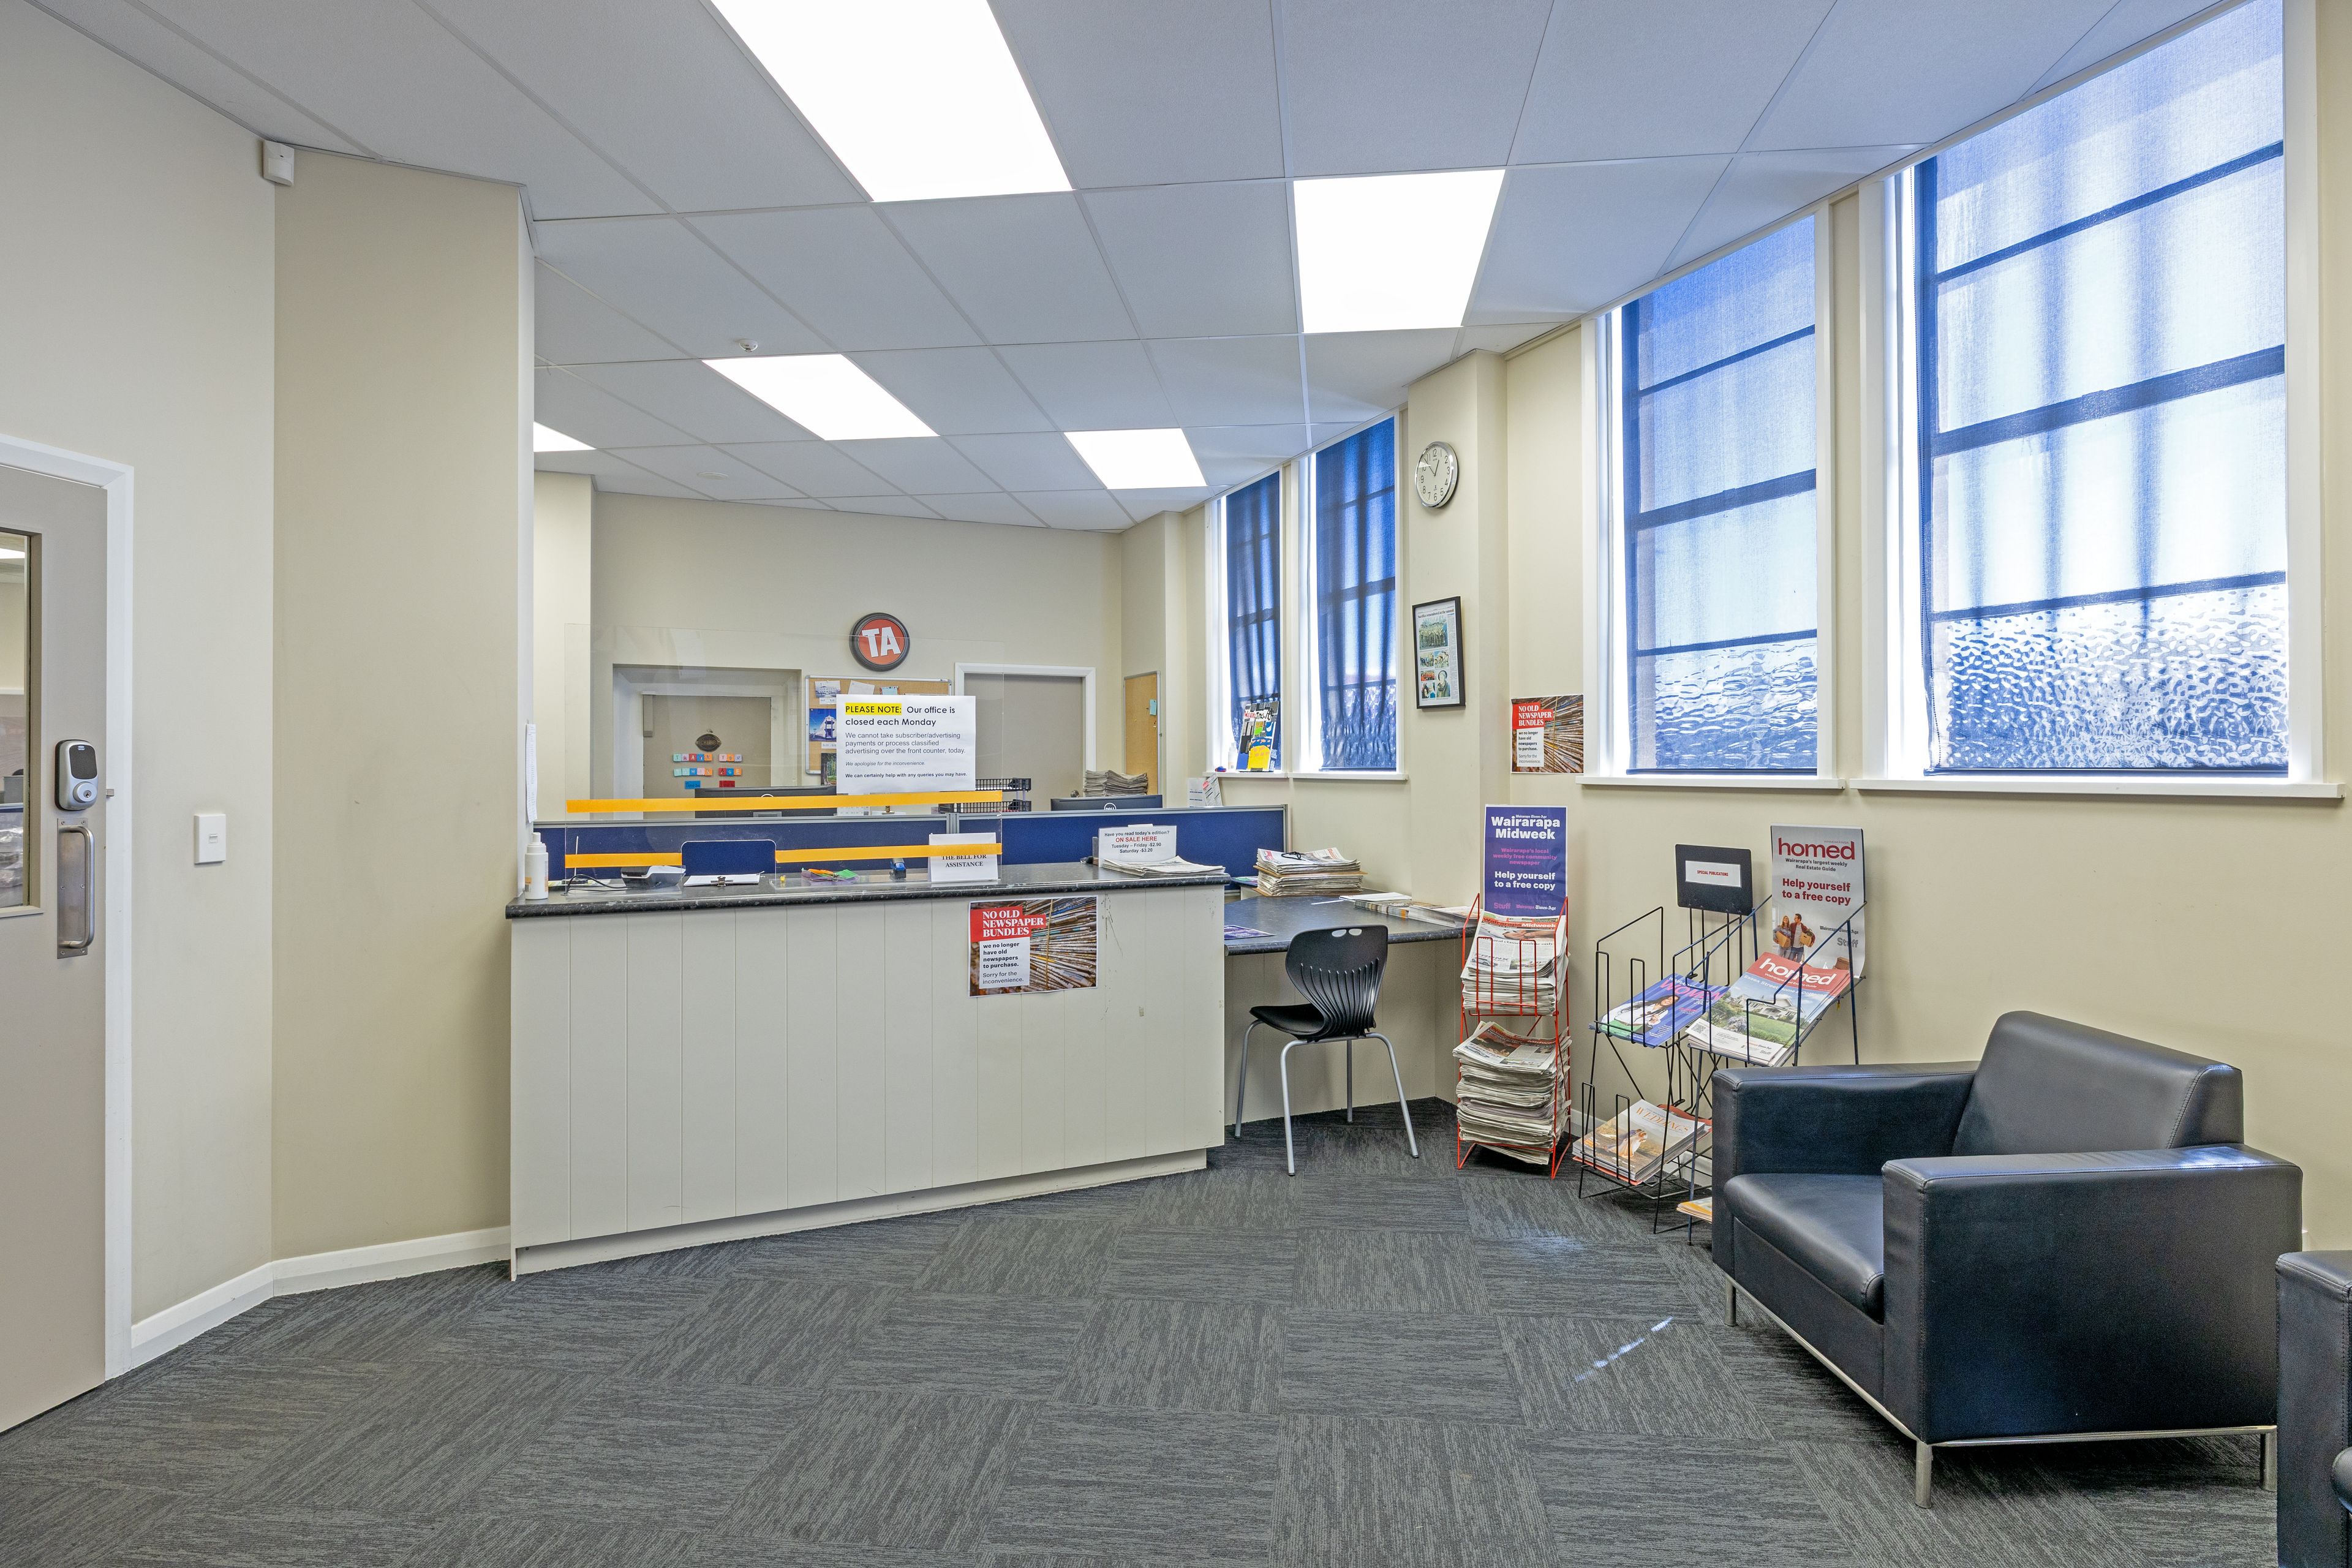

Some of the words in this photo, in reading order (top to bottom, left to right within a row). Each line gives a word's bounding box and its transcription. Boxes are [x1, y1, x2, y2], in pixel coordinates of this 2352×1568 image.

[1433, 448, 1437, 457] 12
[1445, 455, 1448, 464] 2
[1447, 466, 1450, 475] 3
[1428, 492, 1431, 500] 7
[1440, 488, 1444, 496] 5
[862, 627, 901, 657] TA
[1518, 711, 1552, 720] NEWSPAPER
[902, 718, 937, 727] Monday
[1491, 816, 1560, 829] Wairarapa
[1495, 828, 1555, 840] Midweek
[1778, 837, 1855, 860] homed
[1494, 871, 1515, 880] Help
[1533, 882, 1556, 891] copy
[1782, 878, 1805, 889] Help
[1807, 881, 1851, 892] yourself
[1803, 891, 1823, 901] free
[1825, 895, 1851, 907] copy
[982, 910, 997, 919] NO
[999, 910, 1020, 918] OLD
[982, 918, 1044, 929] NEWSPAPER
[982, 927, 1030, 937] BUNDLES
[1759, 957, 1837, 986] homed
[1744, 974, 1760, 983] Essex
